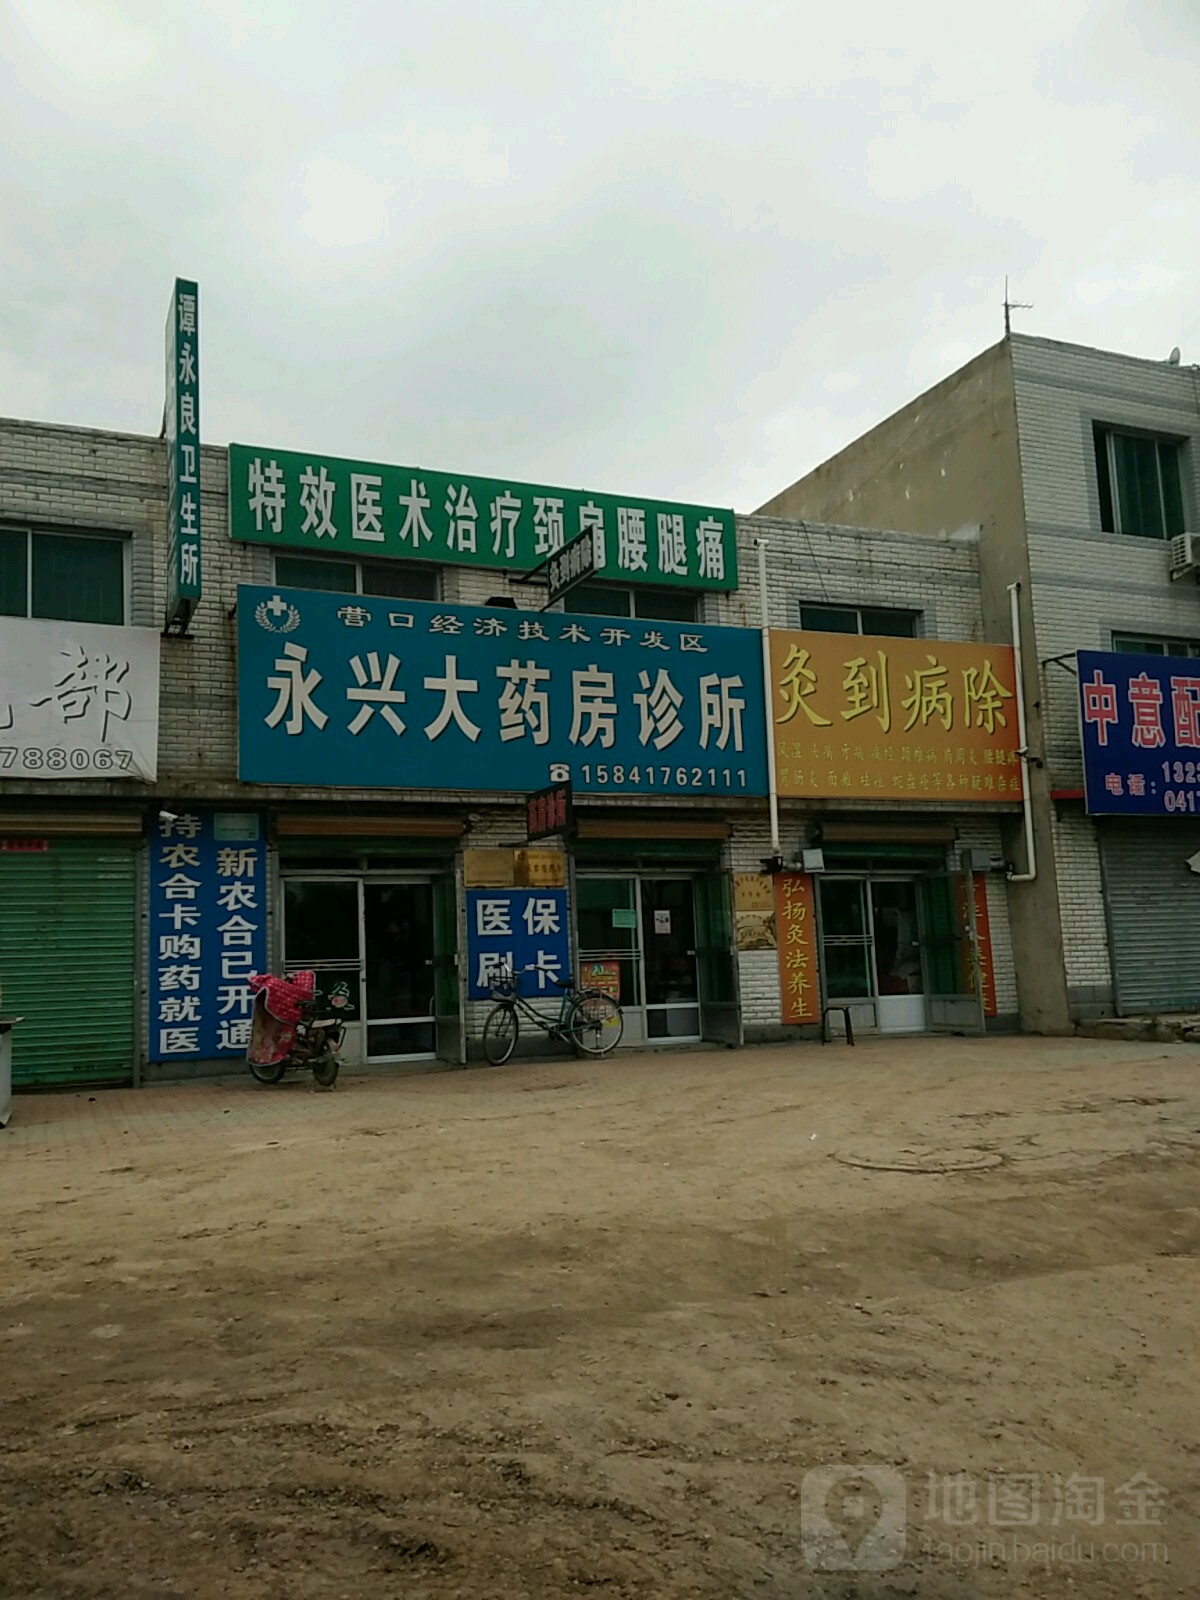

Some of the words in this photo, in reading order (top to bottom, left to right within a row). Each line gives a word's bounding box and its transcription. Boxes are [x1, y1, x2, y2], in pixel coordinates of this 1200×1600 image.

[178, 293, 198, 586] 谭永良卫生所
[337, 606, 708, 653] 营口经济技术开发区
[264, 641, 746, 752] 永兴大药房诊所
[776, 643, 1013, 735] 灸到病除
[0, 747, 133, 770] 788067
[581, 764, 747, 788] 15841762111
[216, 847, 259, 1050] 新农合已开通
[781, 878, 813, 1018] 弘扬灸法养生
